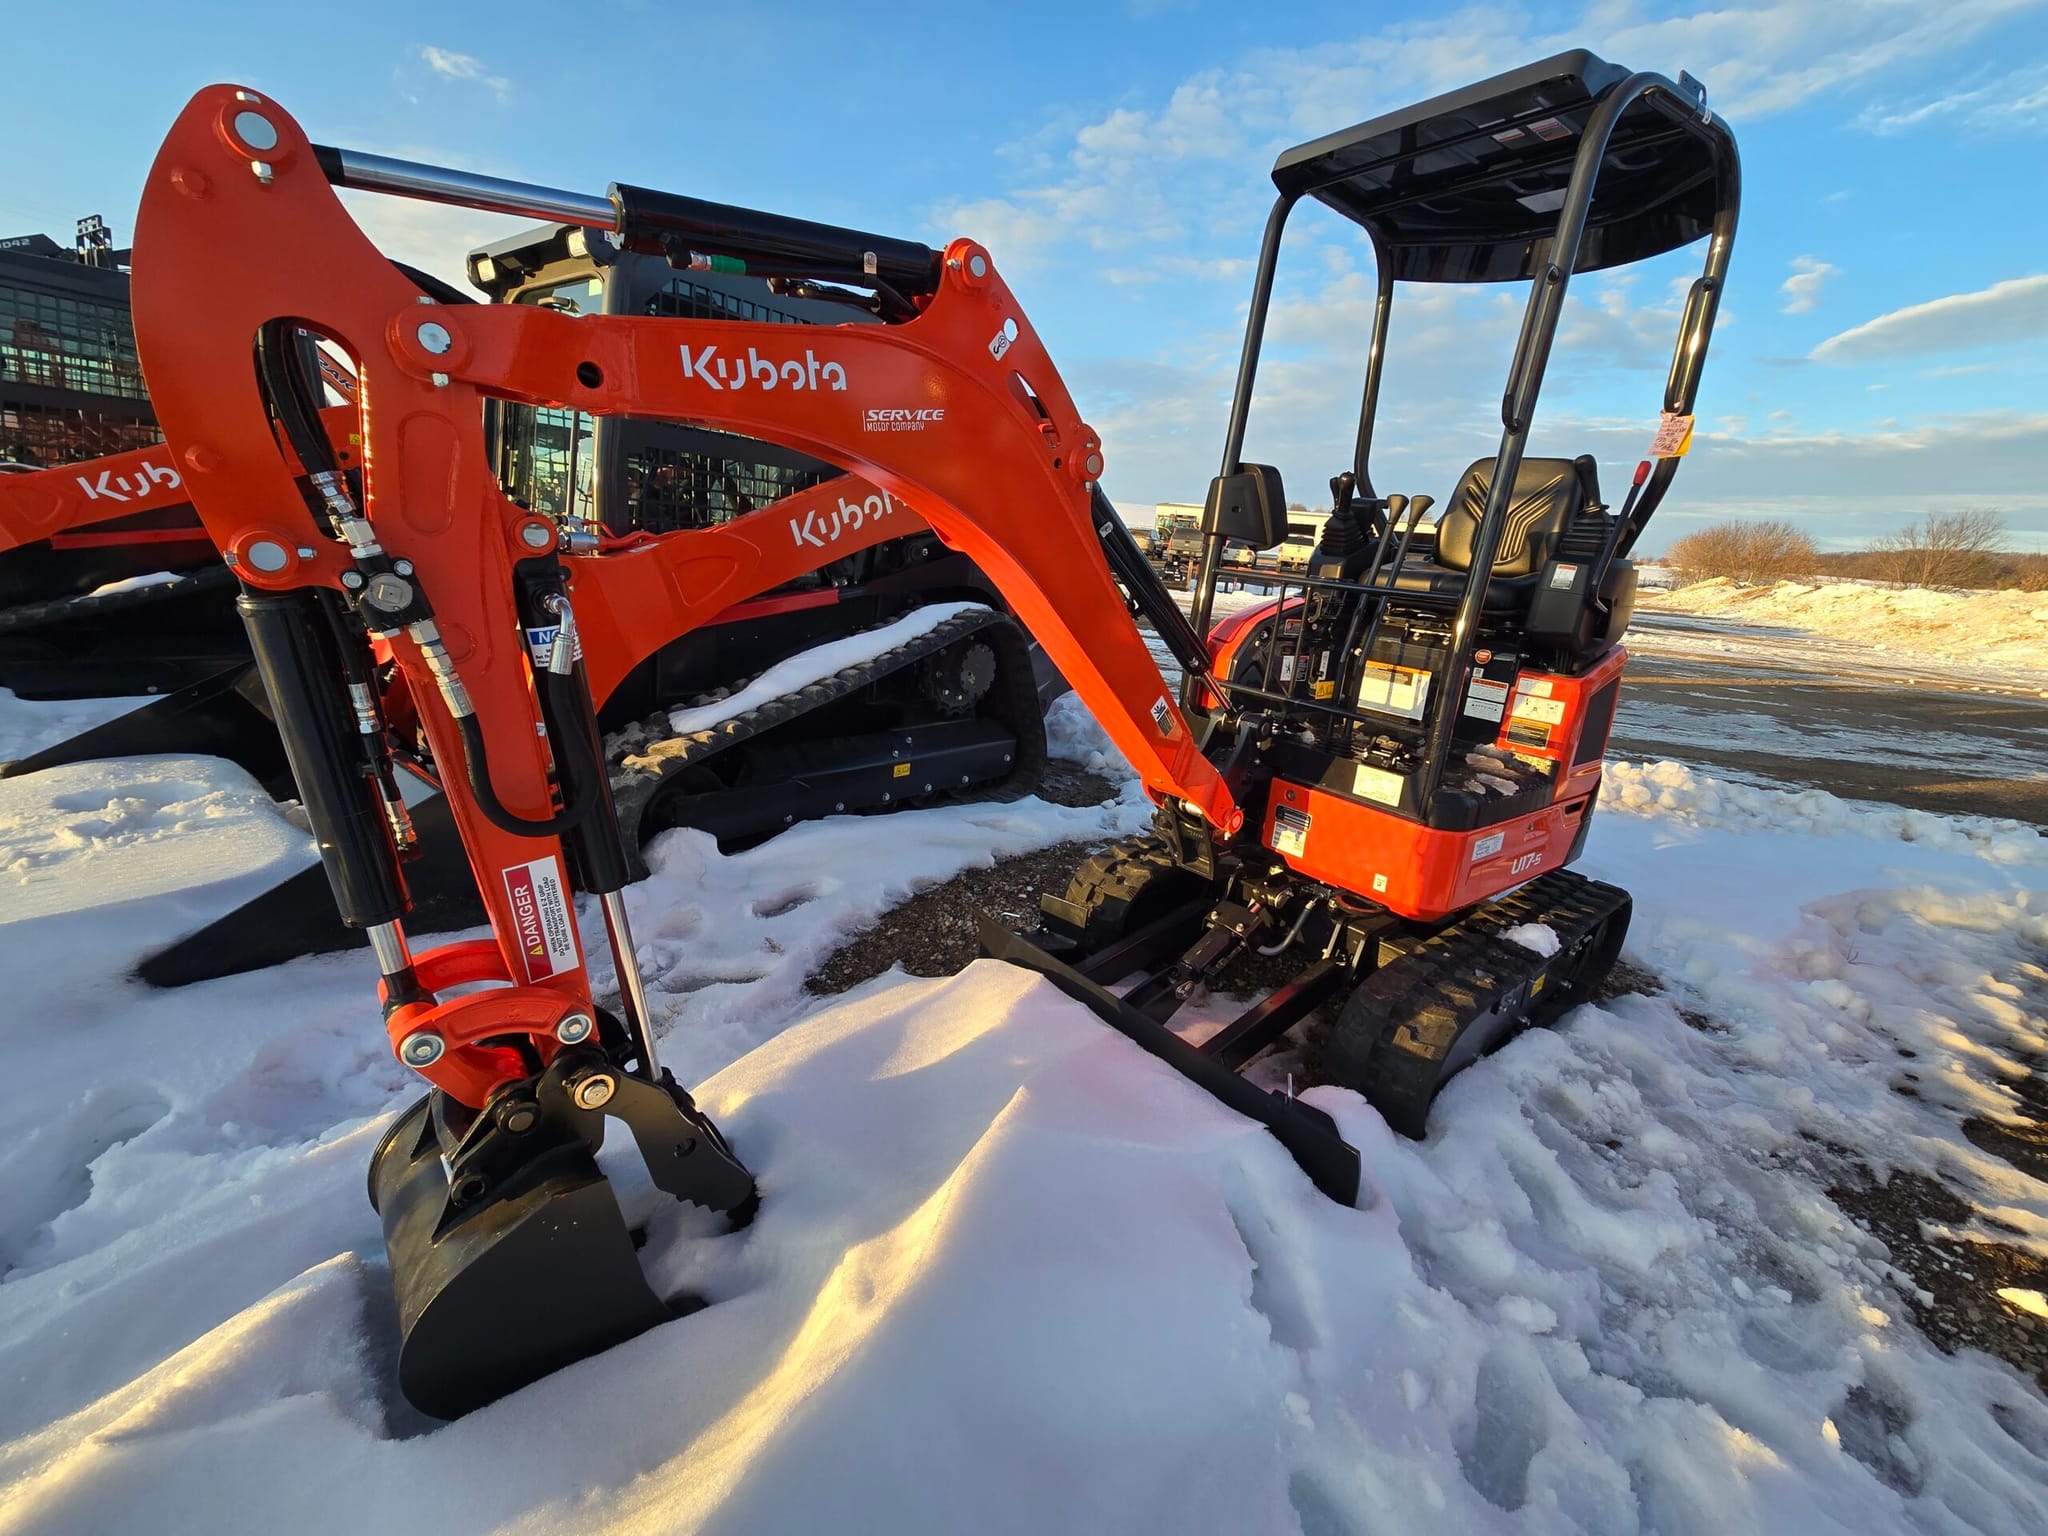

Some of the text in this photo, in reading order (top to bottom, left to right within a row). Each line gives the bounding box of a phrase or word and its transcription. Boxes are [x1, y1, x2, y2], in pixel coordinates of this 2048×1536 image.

[680, 345, 847, 391] Kubota
[866, 409, 944, 421] SERVICE
[537, 883, 545, 897] GRIP
[542, 876, 550, 891] LOAD
[545, 891, 553, 905] WITH
[549, 878, 560, 907] CENTERED
[515, 884, 541, 946] DANGER
[543, 907, 554, 936] OPERATING
[549, 906, 560, 936] TRANSPORT
[557, 913, 565, 927] LOAD
[550, 936, 558, 952] WHEN
